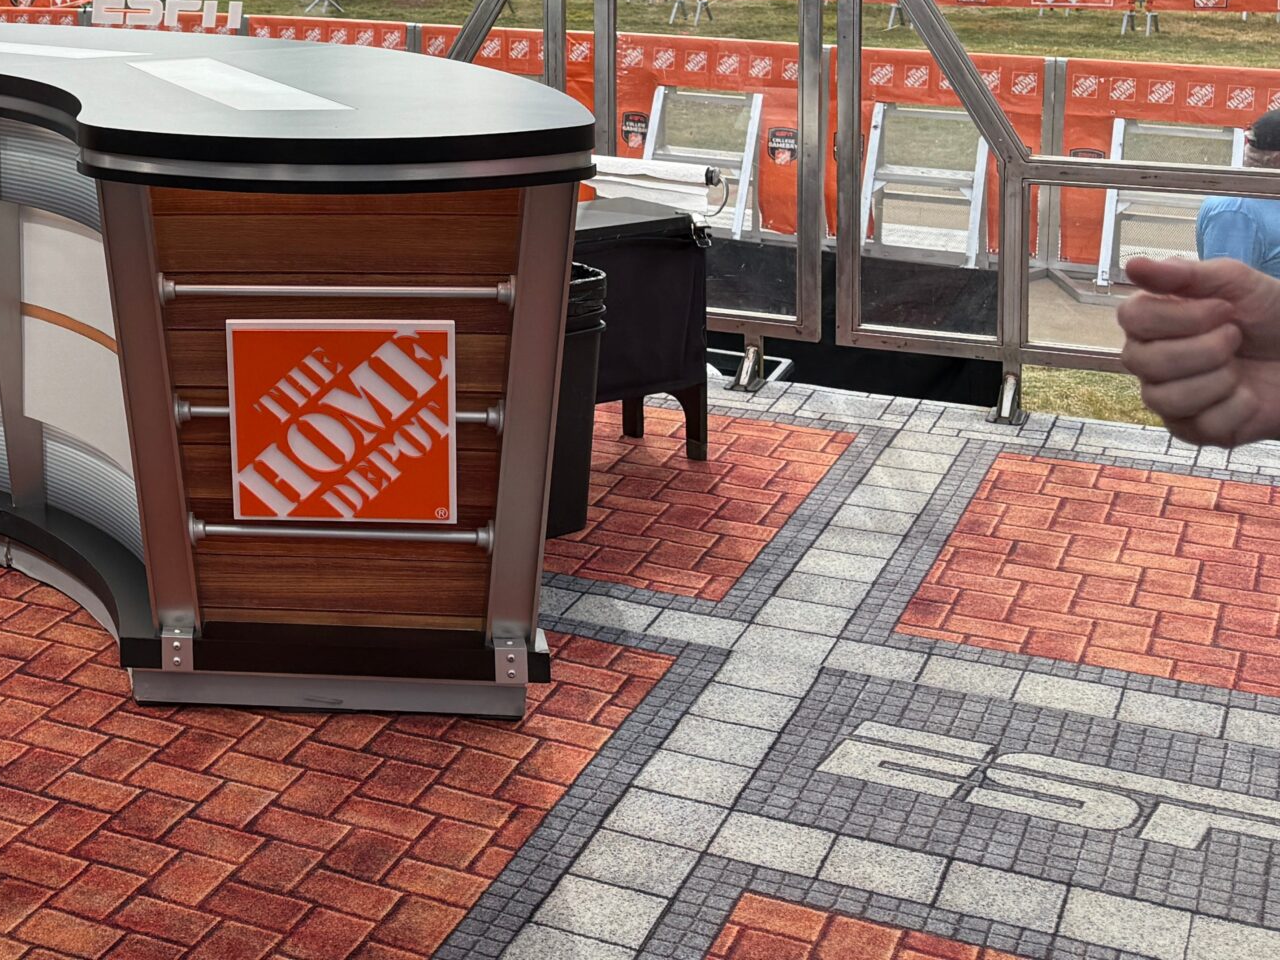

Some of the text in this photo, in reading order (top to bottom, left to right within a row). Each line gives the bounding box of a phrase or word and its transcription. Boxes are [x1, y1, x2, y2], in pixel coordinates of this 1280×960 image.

[869, 64, 894, 85] HOME
[904, 65, 929, 87] HOME
[1011, 72, 1038, 94] HOME
[1072, 75, 1098, 98] HOME
[1109, 78, 1136, 100] HOME
[1147, 80, 1175, 104] HOME
[1186, 83, 1215, 107] HOME
[1226, 86, 1255, 110] HOME
[253, 346, 344, 424] THE
[237, 328, 449, 518] HOME
[321, 400, 449, 519] DEPOT
